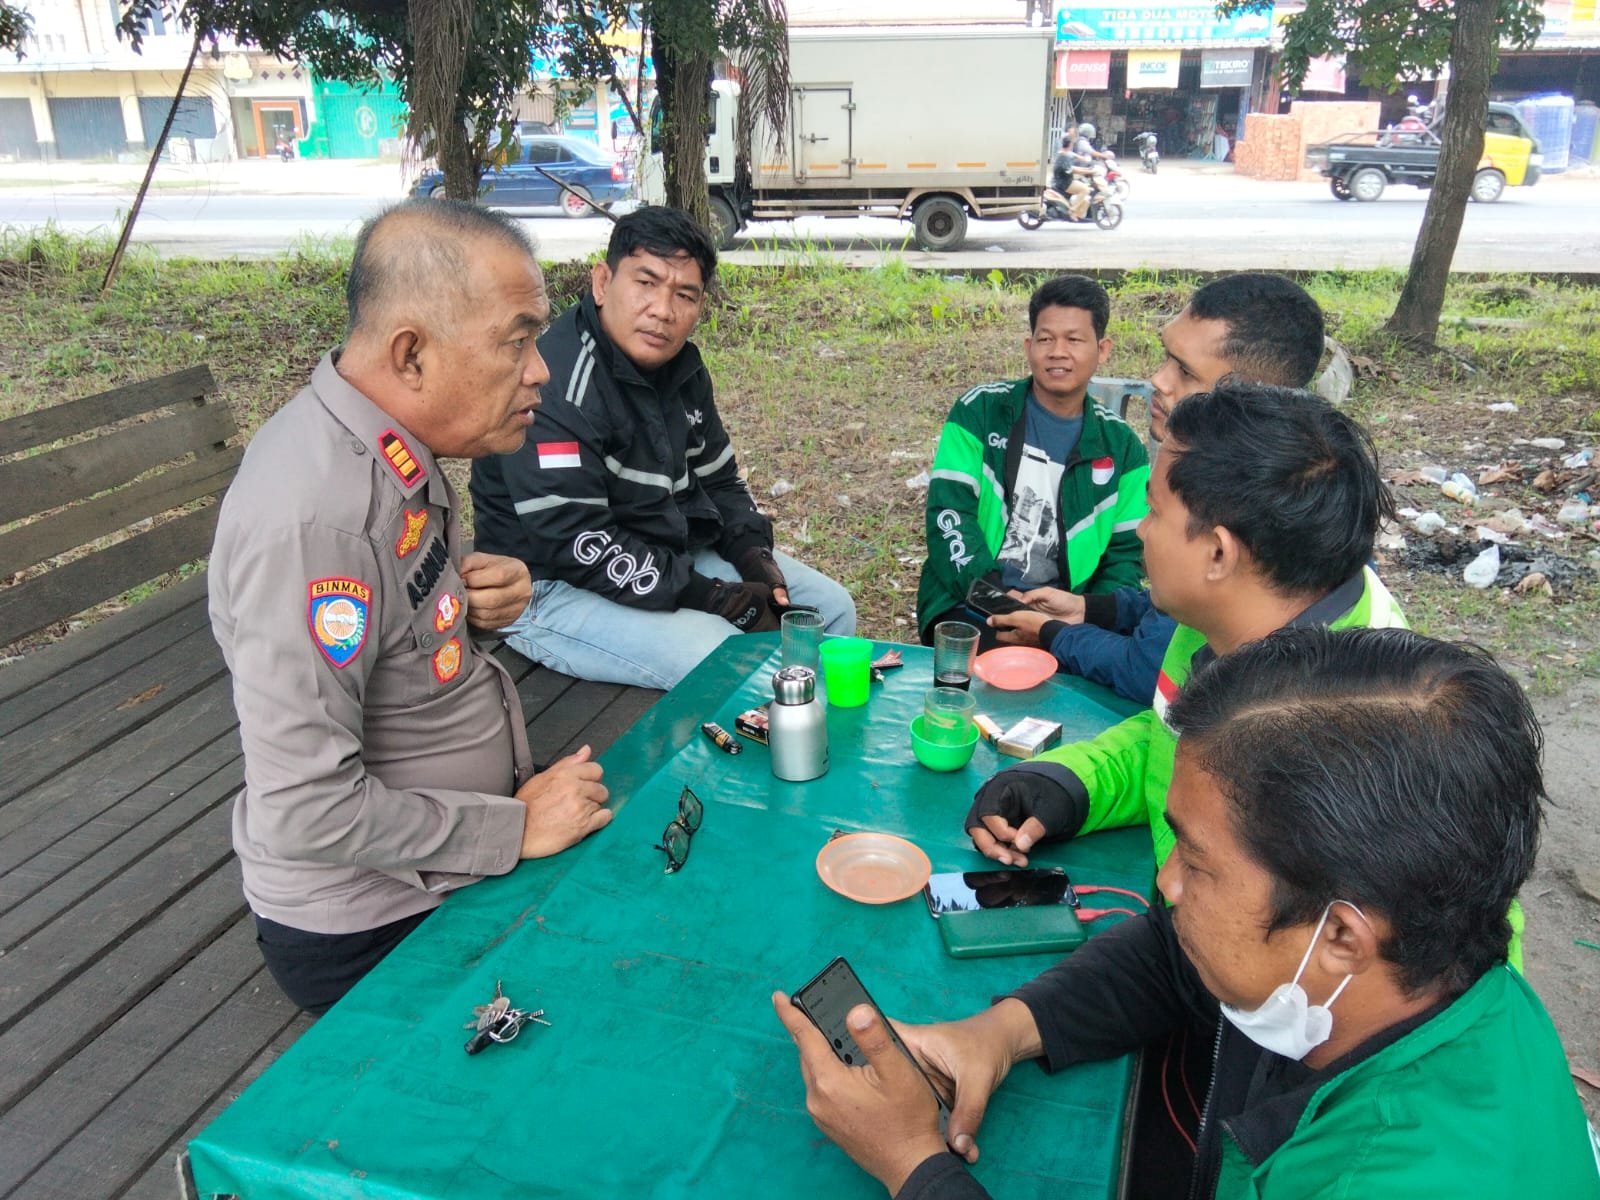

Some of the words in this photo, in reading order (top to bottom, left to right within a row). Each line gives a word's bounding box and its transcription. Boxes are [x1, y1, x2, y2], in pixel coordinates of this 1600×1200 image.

[1103, 9, 1136, 19] TIGA
[1142, 9, 1171, 19] DUA
[1176, 8, 1219, 19] MOTO
[1069, 63, 1107, 73] DENSO
[573, 530, 660, 596] Grab
[315, 580, 367, 599] BINMAS
